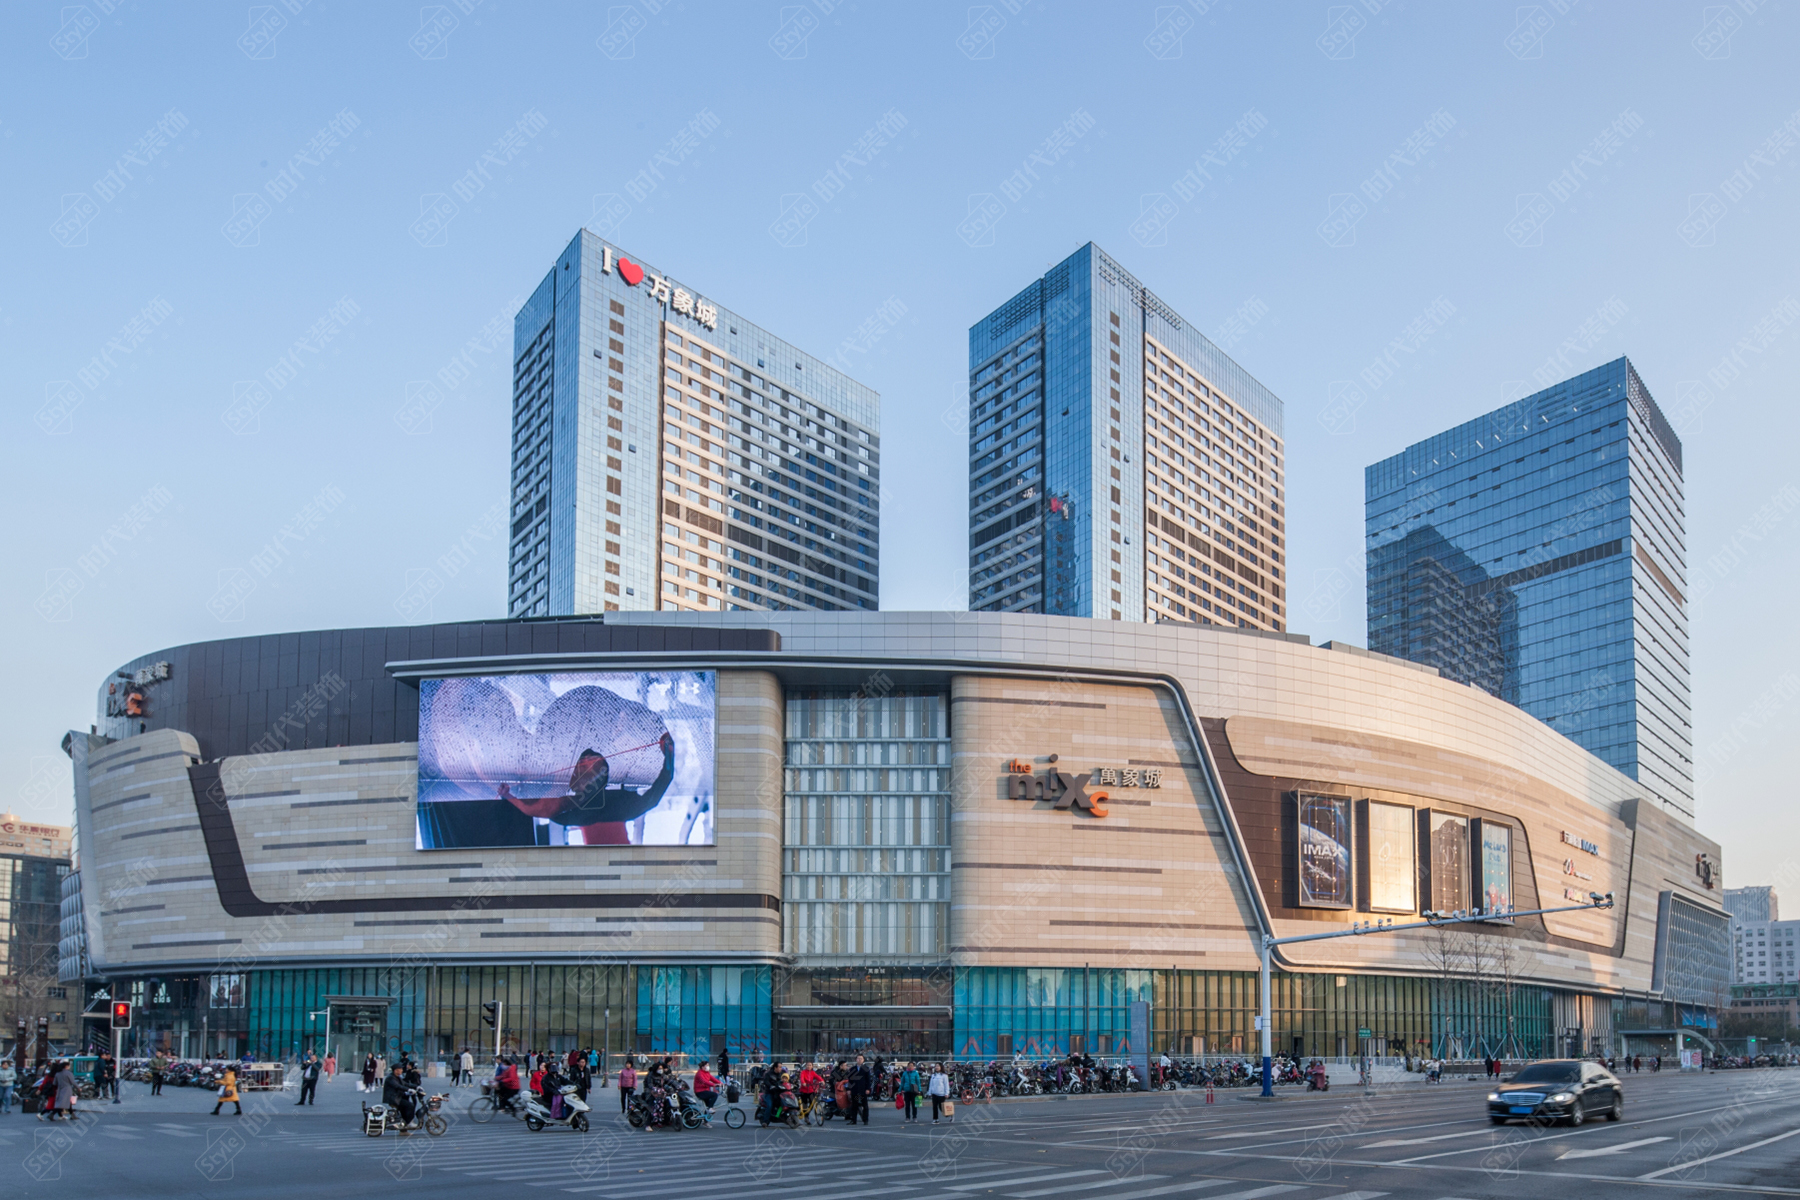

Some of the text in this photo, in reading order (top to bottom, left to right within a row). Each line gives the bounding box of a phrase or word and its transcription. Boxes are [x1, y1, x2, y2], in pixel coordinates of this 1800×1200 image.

[603, 246, 718, 330] I 万象城
[1009, 758, 1032, 773] the
[1100, 768, 1163, 788] 萬象城
[1304, 844, 1343, 858] IMAX
